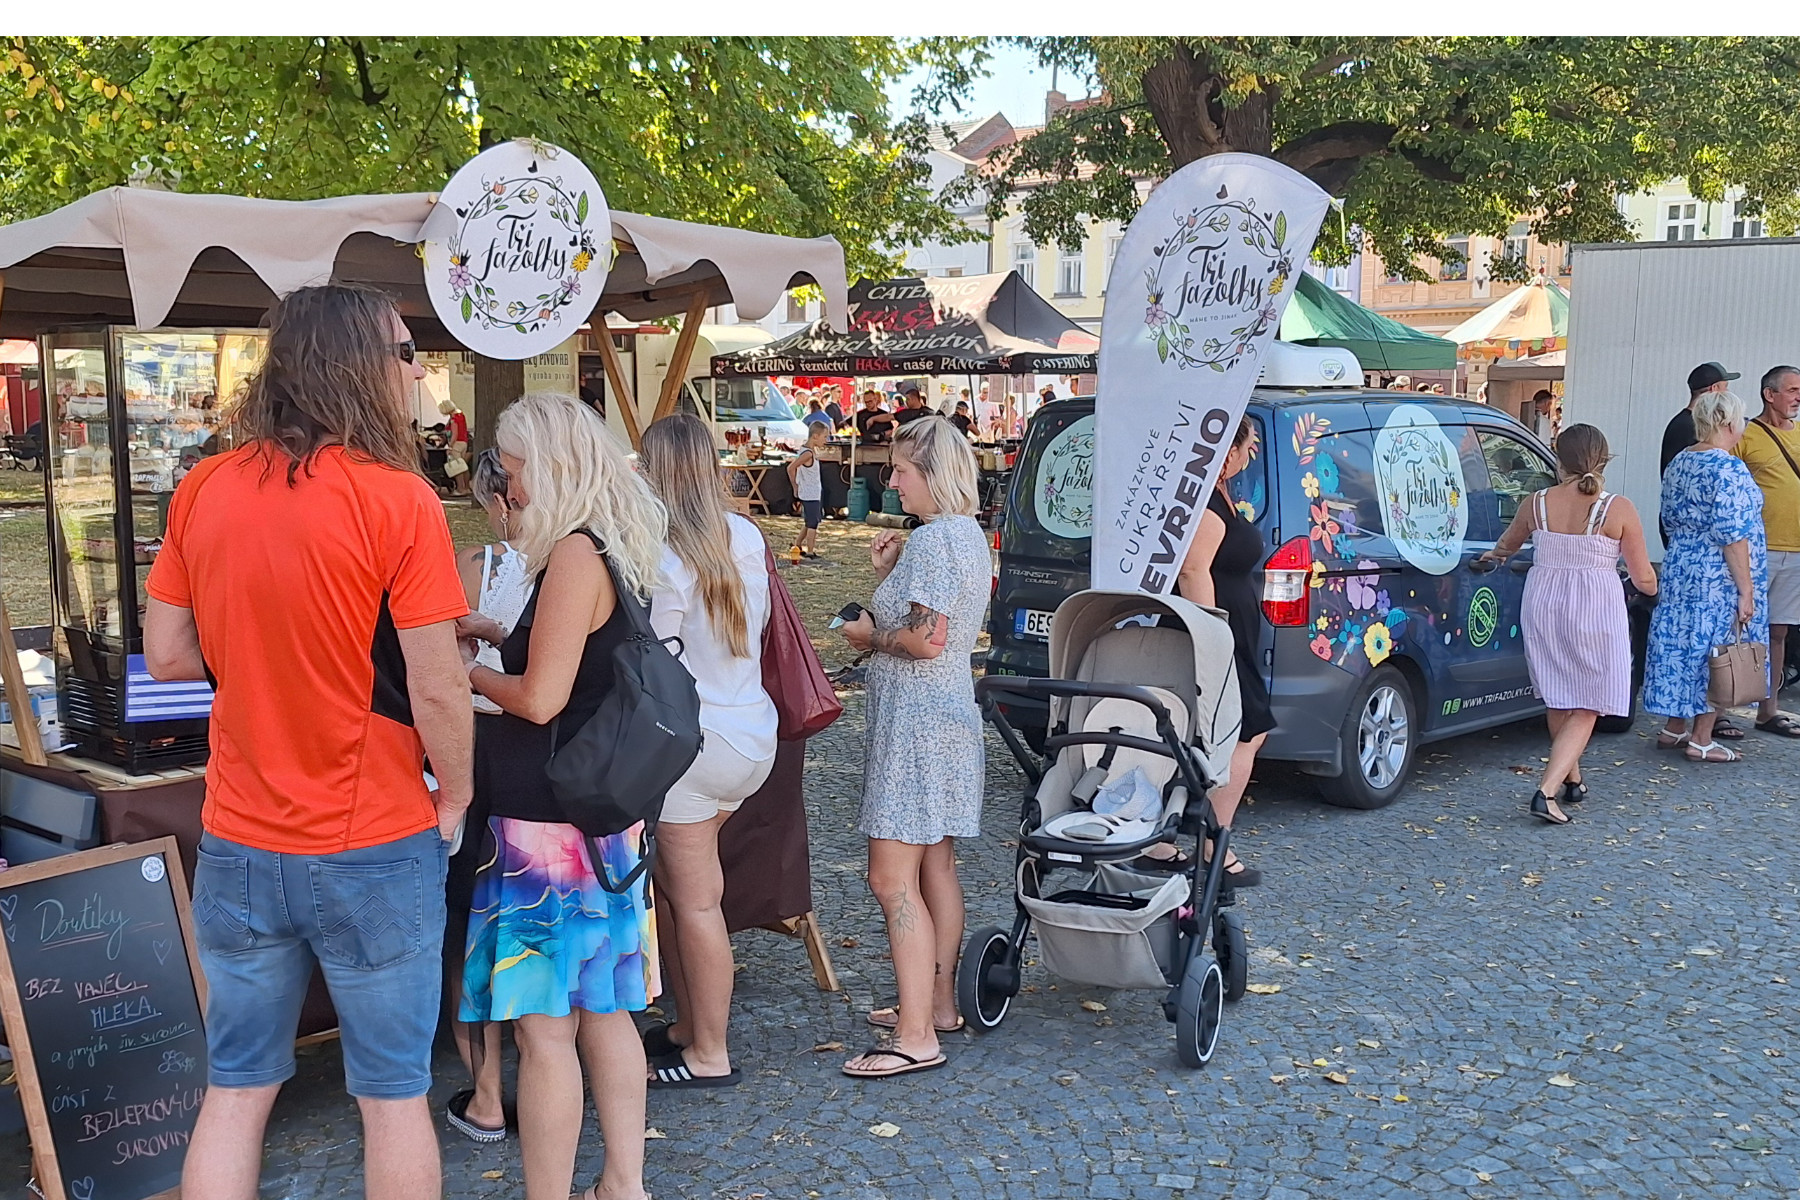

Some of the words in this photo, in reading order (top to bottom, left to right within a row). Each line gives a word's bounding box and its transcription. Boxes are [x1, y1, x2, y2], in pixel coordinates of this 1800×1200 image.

[496, 208, 538, 253] Tři
[479, 236, 568, 281] fazolky
[1187, 237, 1229, 285] Tři
[867, 281, 980, 301] CATERING
[1175, 265, 1263, 319] fazolky
[850, 302, 939, 332] HAŠA
[734, 358, 795, 373] CATERING
[799, 357, 849, 372] řeznictví
[902, 358, 934, 371] naše
[1032, 355, 1091, 374] CATERING
[1115, 427, 1161, 530] ZAKÁZKOVÉ
[1119, 400, 1197, 575] CUKRÁŘSTVÍ
[1137, 408, 1230, 597] EVŘENO
[1007, 568, 1053, 579] TRANSIT
[24, 977, 64, 1001] BEZ
[51, 1051, 61, 1064] a
